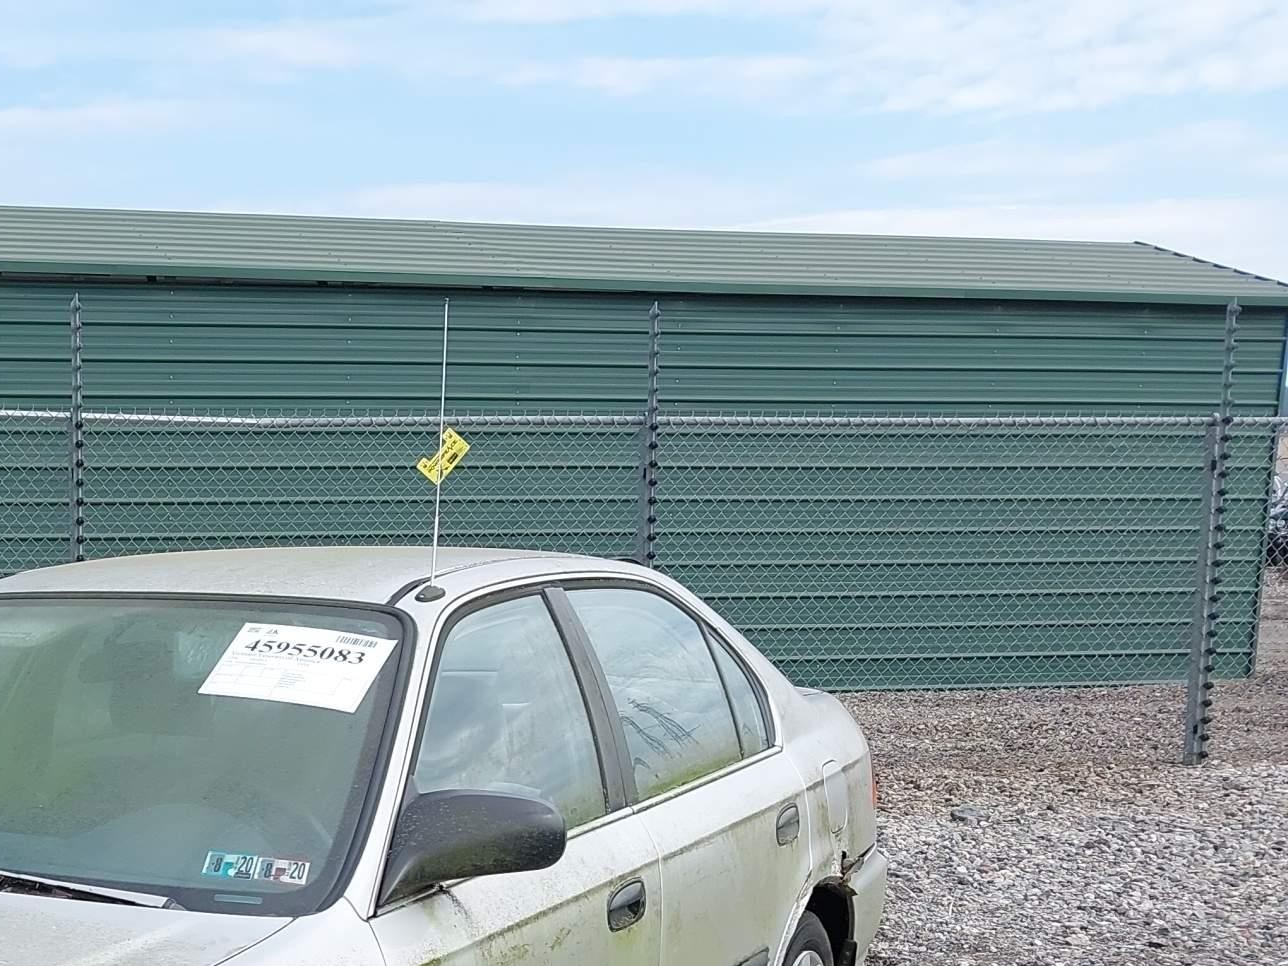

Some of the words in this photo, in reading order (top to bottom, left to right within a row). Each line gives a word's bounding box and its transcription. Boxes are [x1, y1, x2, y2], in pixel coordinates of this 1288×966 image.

[244, 638, 367, 665] 45955083
[237, 856, 254, 873] 20
[289, 862, 306, 880] 20
